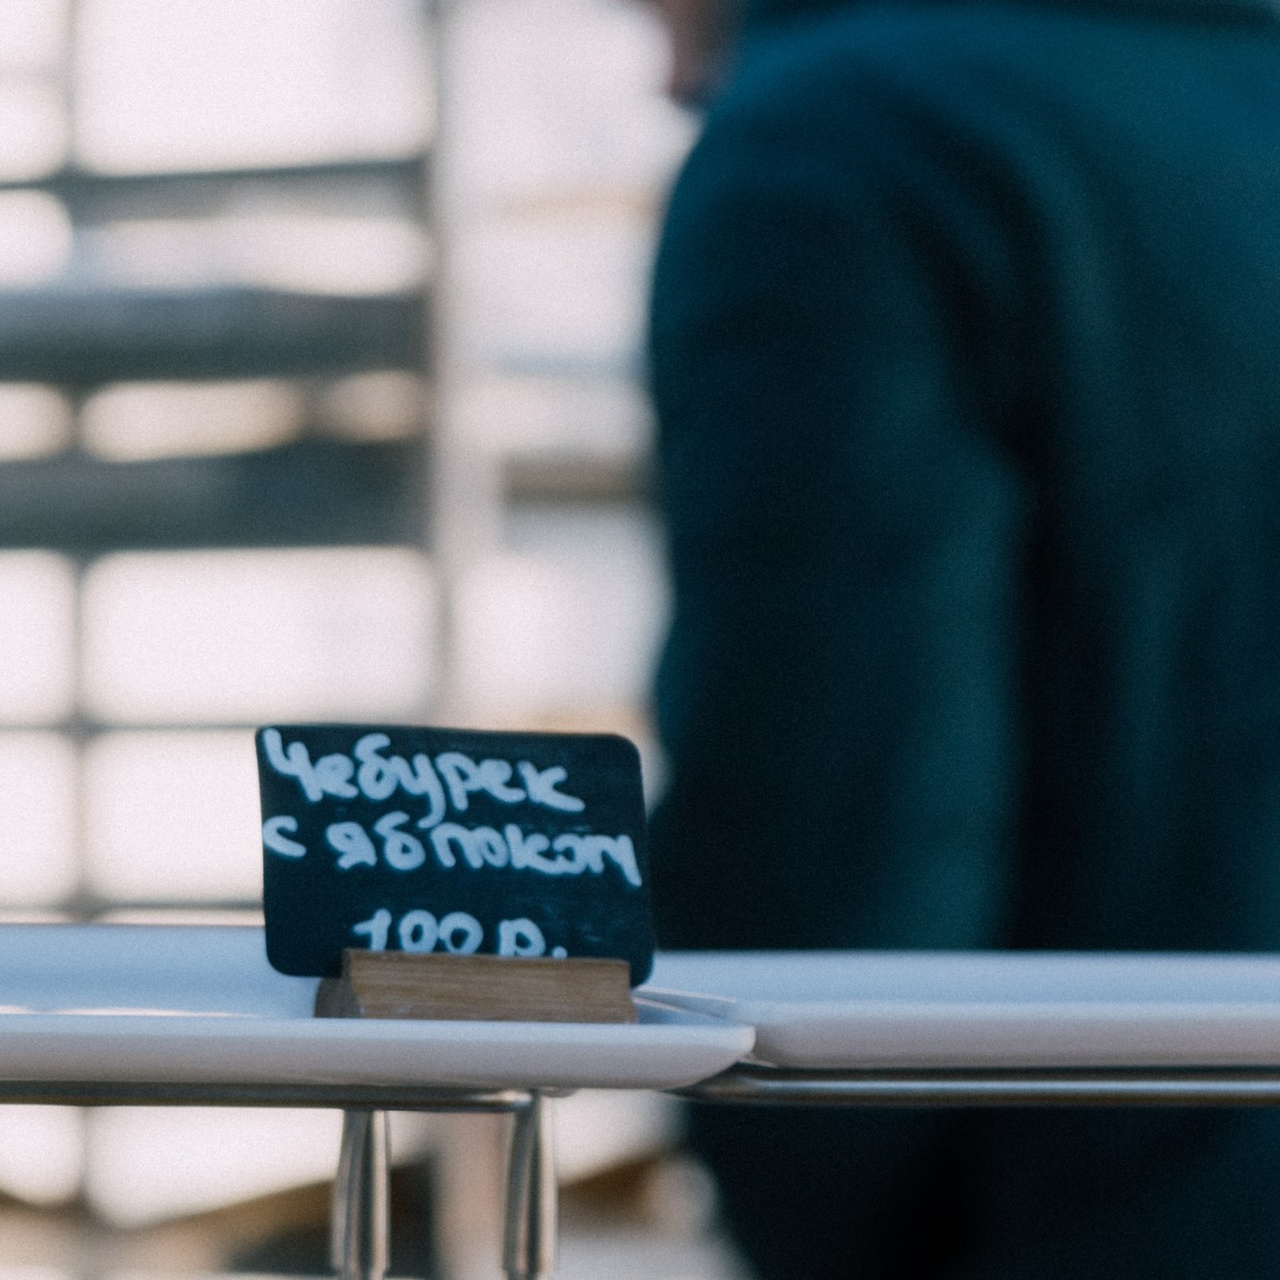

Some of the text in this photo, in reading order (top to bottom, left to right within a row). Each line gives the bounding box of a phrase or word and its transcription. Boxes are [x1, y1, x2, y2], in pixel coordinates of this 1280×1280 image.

[262, 727, 586, 829] Чебурек
[325, 810, 642, 888] яблоком
[351, 907, 484, 954] 100
